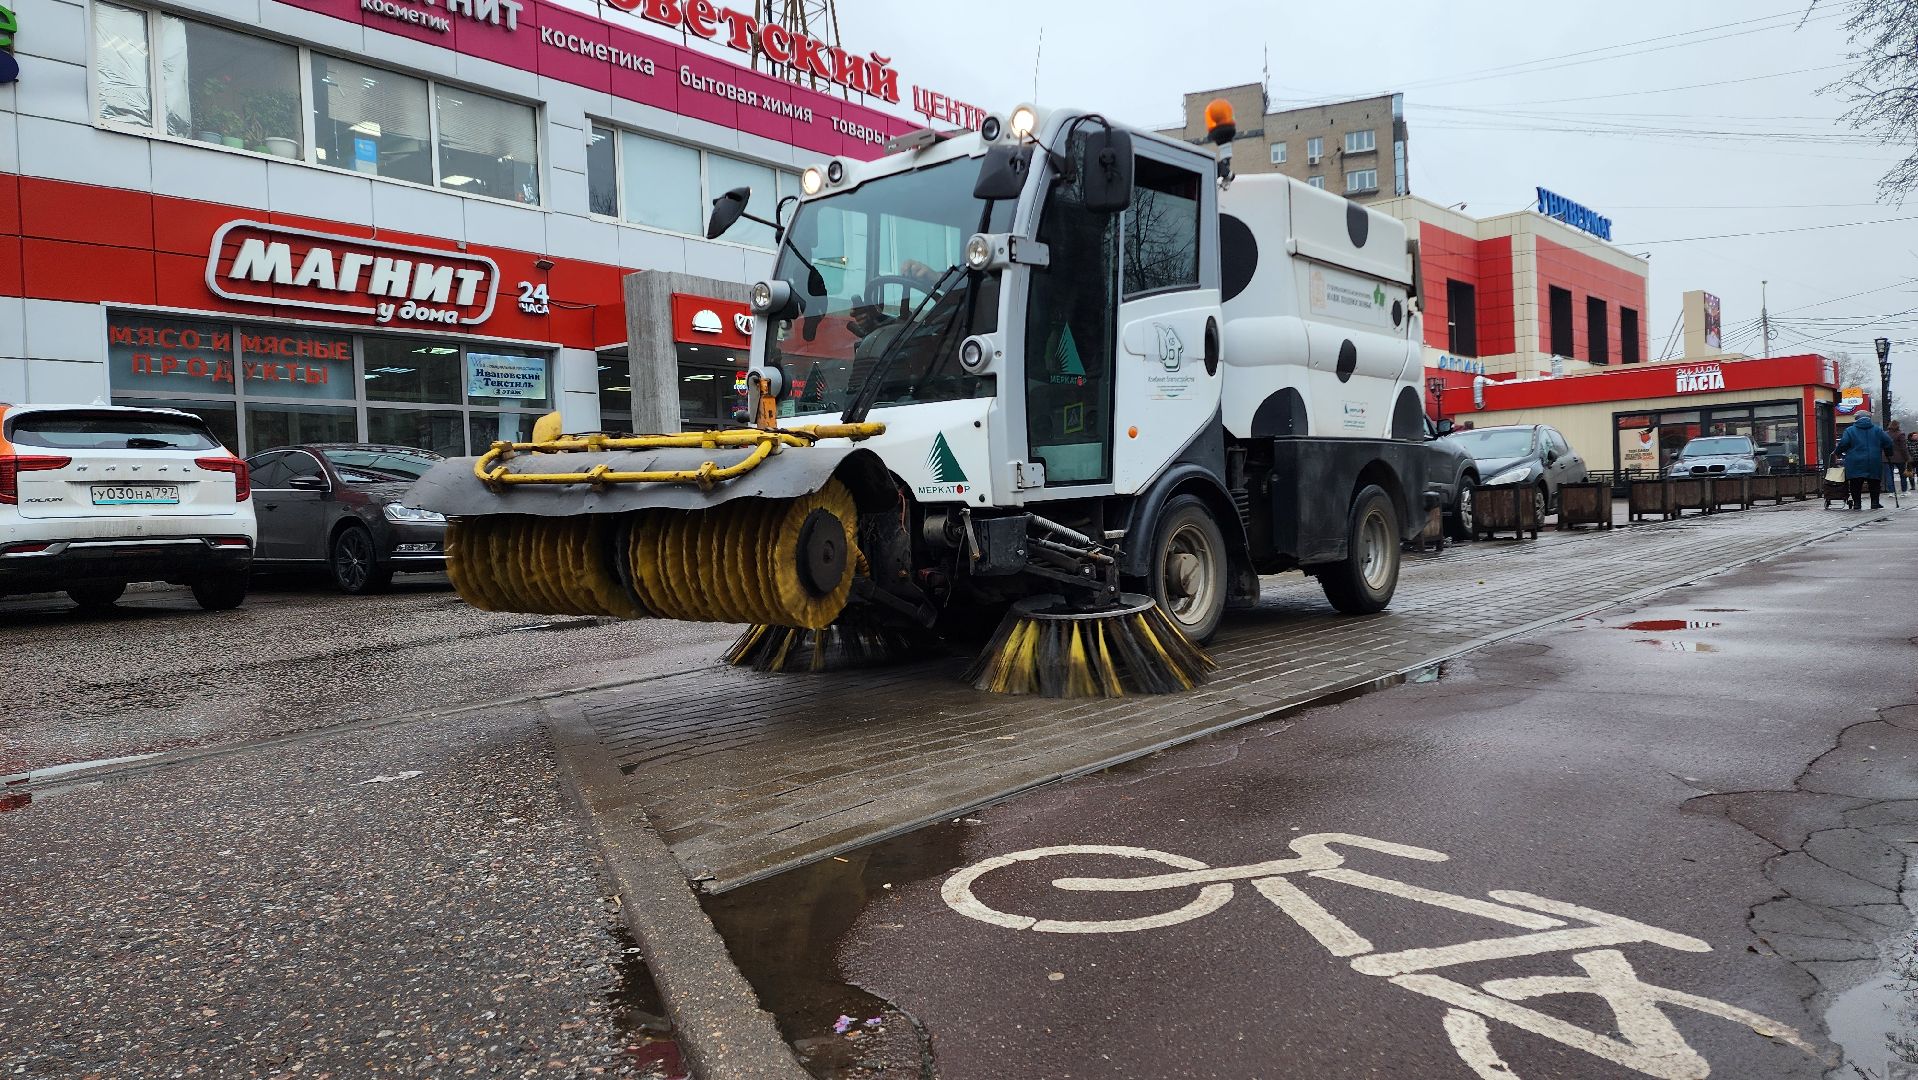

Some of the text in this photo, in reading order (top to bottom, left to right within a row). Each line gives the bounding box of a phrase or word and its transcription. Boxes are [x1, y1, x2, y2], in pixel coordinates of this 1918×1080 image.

[361, 0, 450, 32] косметик
[424, 0, 524, 32] НИТ
[541, 25, 655, 76] косметика
[679, 65, 813, 124] бытовая химия
[912, 84, 988, 132] ЦЕНТР
[831, 115, 886, 145] товары
[1536, 186, 1613, 242] УНИВЕРМАГ
[229, 238, 485, 306] МАГНИТ
[518, 280, 550, 304] 24
[375, 301, 459, 324] у дома
[519, 302, 550, 315] ЧАСА
[109, 325, 350, 361] МЯСО И МЯСНЫЕ
[132, 353, 328, 384] ПРОДУКТЫ
[475, 368, 540, 380] Ивановский
[483, 377, 535, 388] Текстиль
[1676, 373, 1726, 393] ПАСТА
[76, 464, 192, 473] HAVAL
[97, 487, 151, 500] У030НА
[918, 484, 971, 494] МЕРКАТОР
